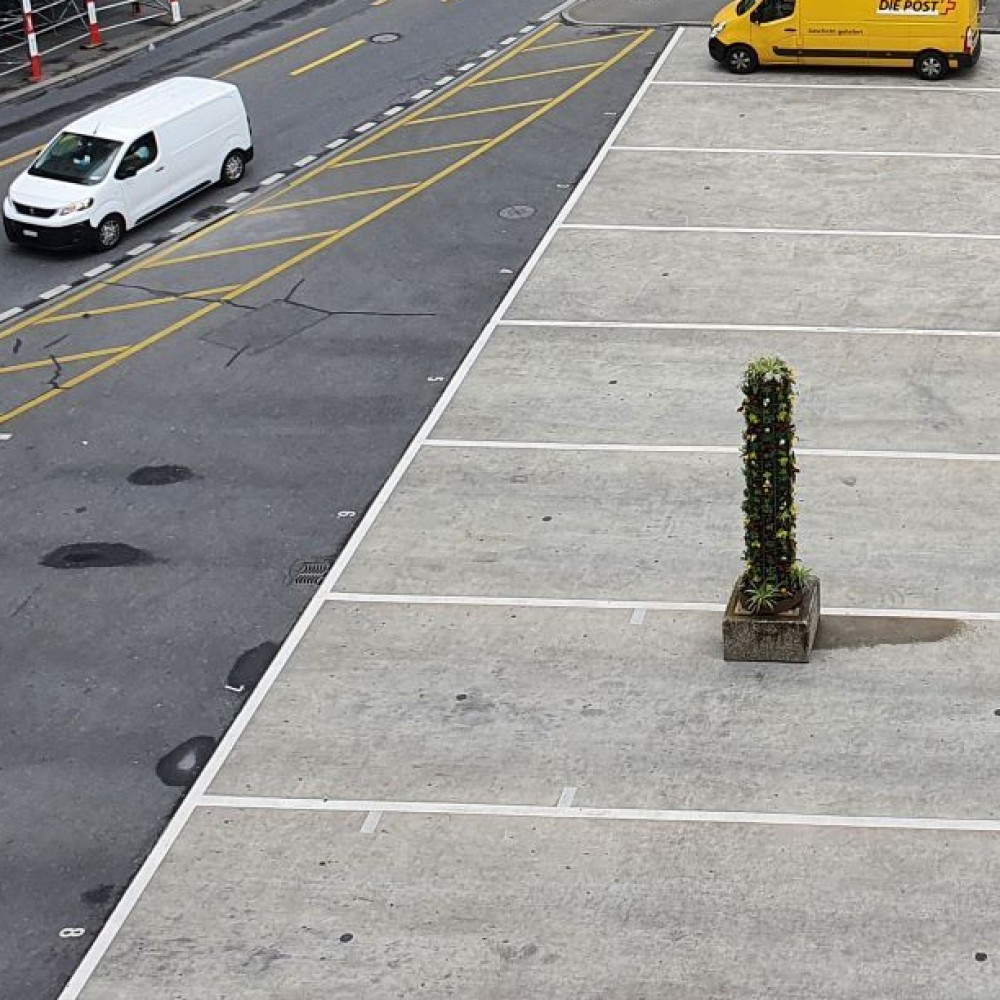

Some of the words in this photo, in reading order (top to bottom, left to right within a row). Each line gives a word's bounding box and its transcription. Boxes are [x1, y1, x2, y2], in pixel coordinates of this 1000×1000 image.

[878, 0, 901, 12] DIE
[903, 0, 940, 13] POST
[58, 926, 86, 938] 8
